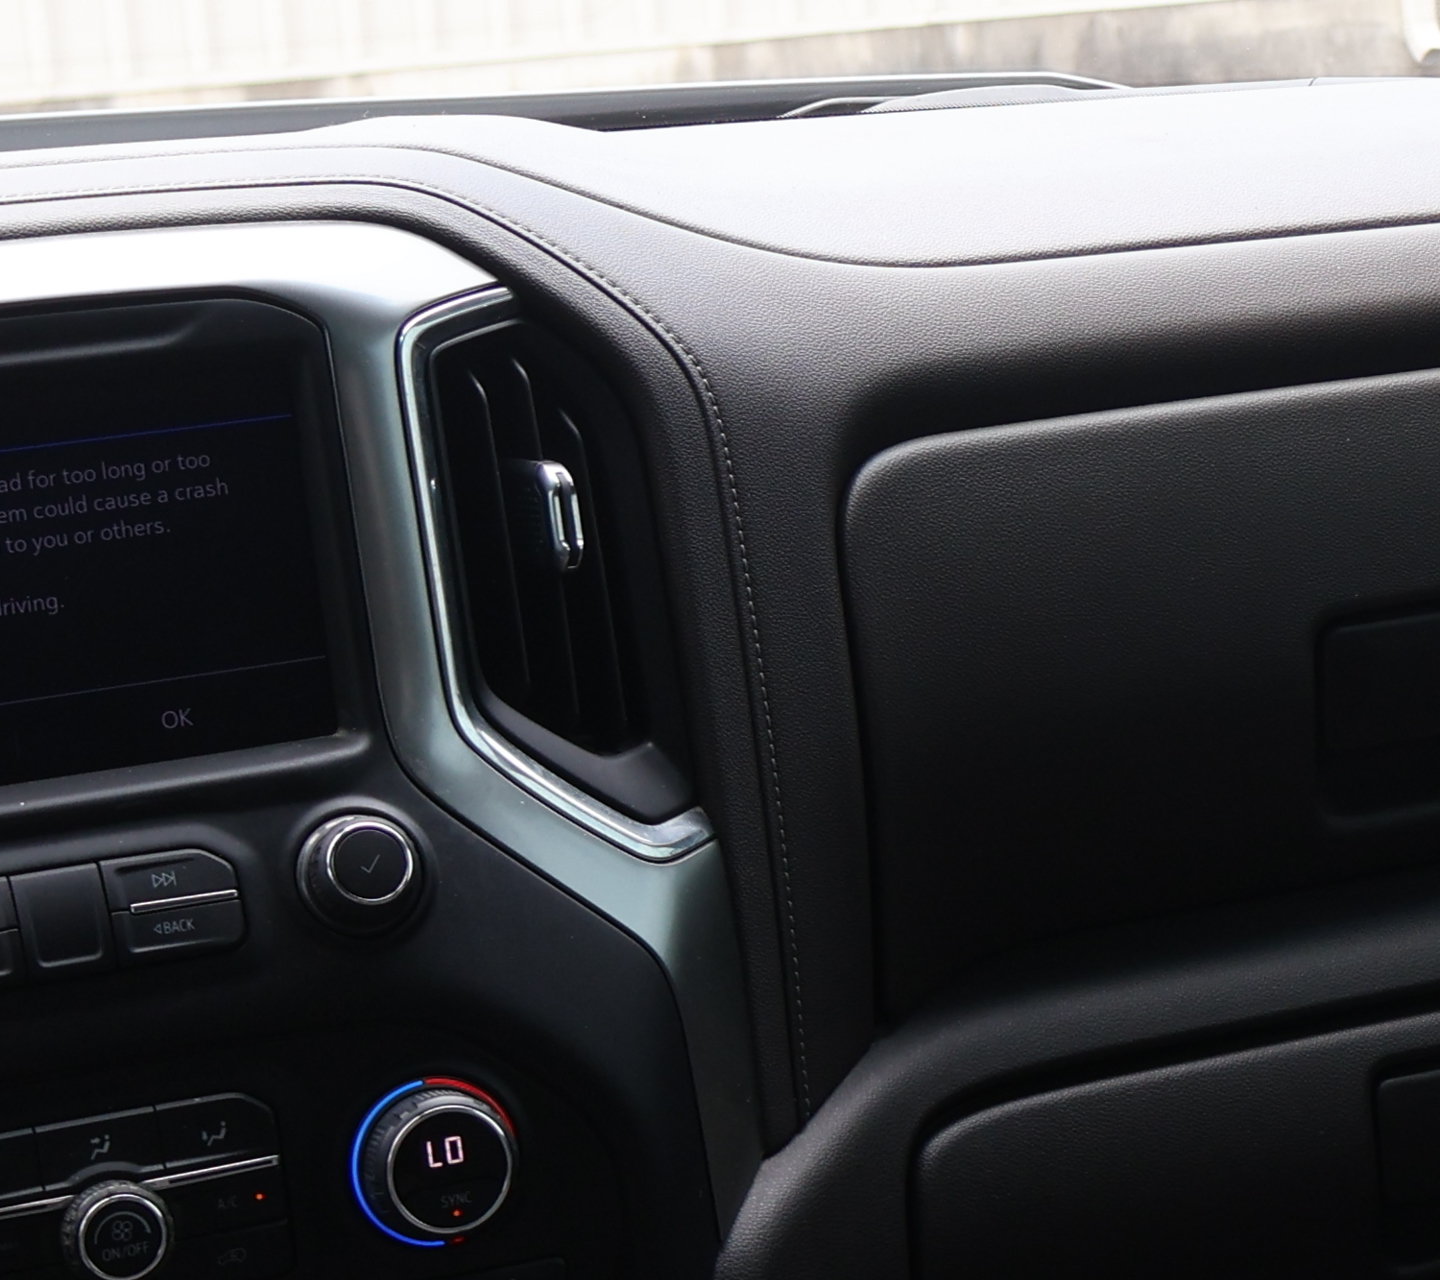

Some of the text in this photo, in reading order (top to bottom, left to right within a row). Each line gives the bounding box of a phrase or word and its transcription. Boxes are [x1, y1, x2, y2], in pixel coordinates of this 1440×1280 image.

[28, 469, 57, 489] for
[62, 466, 97, 485] too
[101, 461, 146, 481] long
[151, 458, 172, 473] or
[177, 454, 211, 471] too
[33, 495, 88, 520] could
[93, 490, 152, 512] cause
[157, 488, 169, 503] a
[175, 477, 229, 501] crash
[5, 537, 27, 554] to
[32, 533, 69, 557] you
[74, 529, 94, 545] or
[100, 520, 171, 543] others.
[161, 708, 194, 730] OK
[163, 919, 196, 934] BACK
[426, 1136, 464, 1168] LO
[440, 1191, 473, 1208] SYNC
[102, 1241, 151, 1261] ON/OFF
